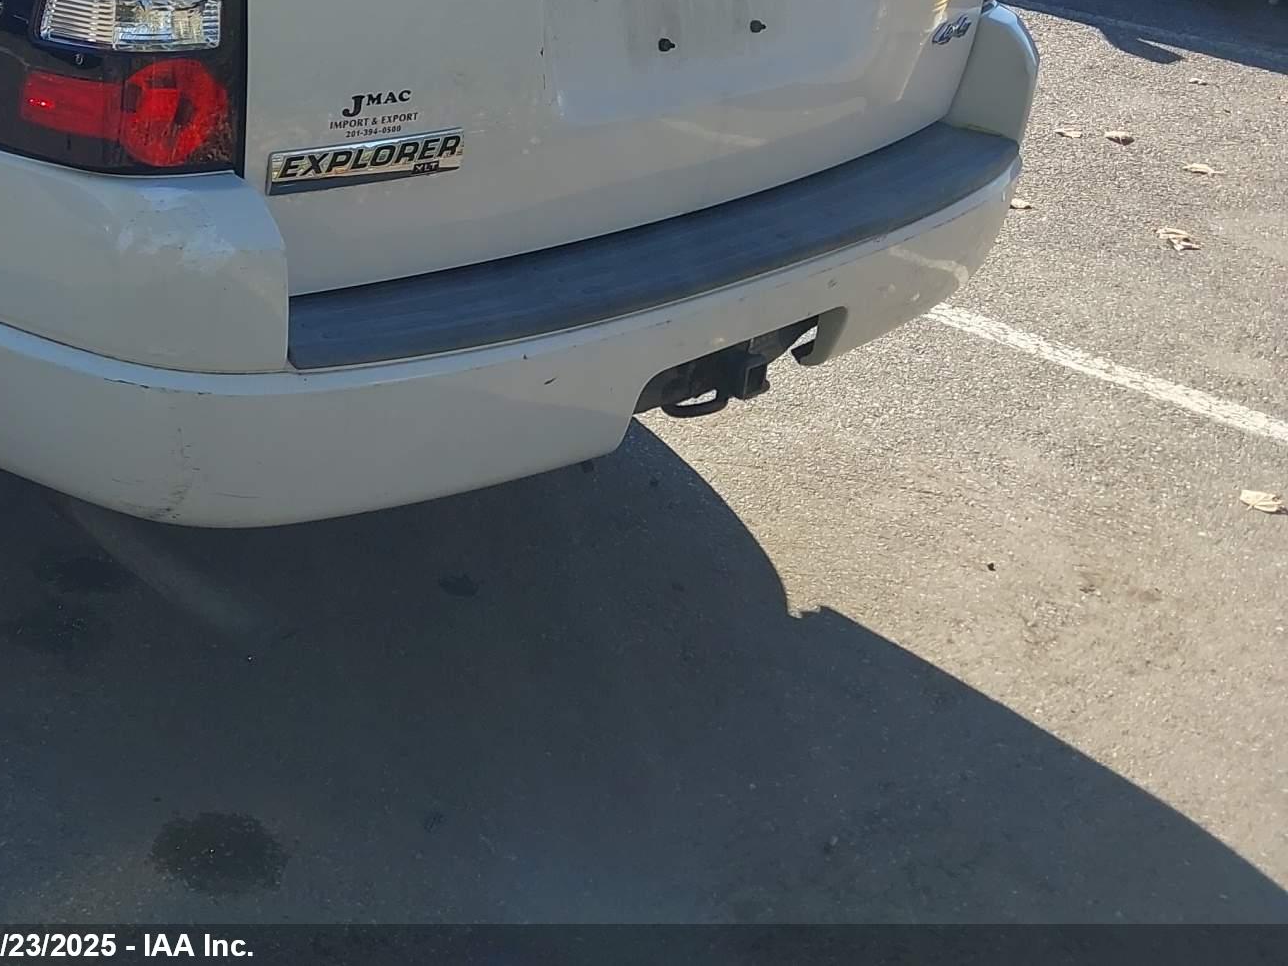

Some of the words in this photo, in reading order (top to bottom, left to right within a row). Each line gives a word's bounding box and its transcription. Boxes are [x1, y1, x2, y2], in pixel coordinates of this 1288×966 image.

[329, 117, 370, 130] IMPORT
[371, 116, 378, 126] &
[380, 112, 419, 125] EXPORT
[277, 134, 461, 179] EXPLORER
[413, 161, 439, 173] XLT
